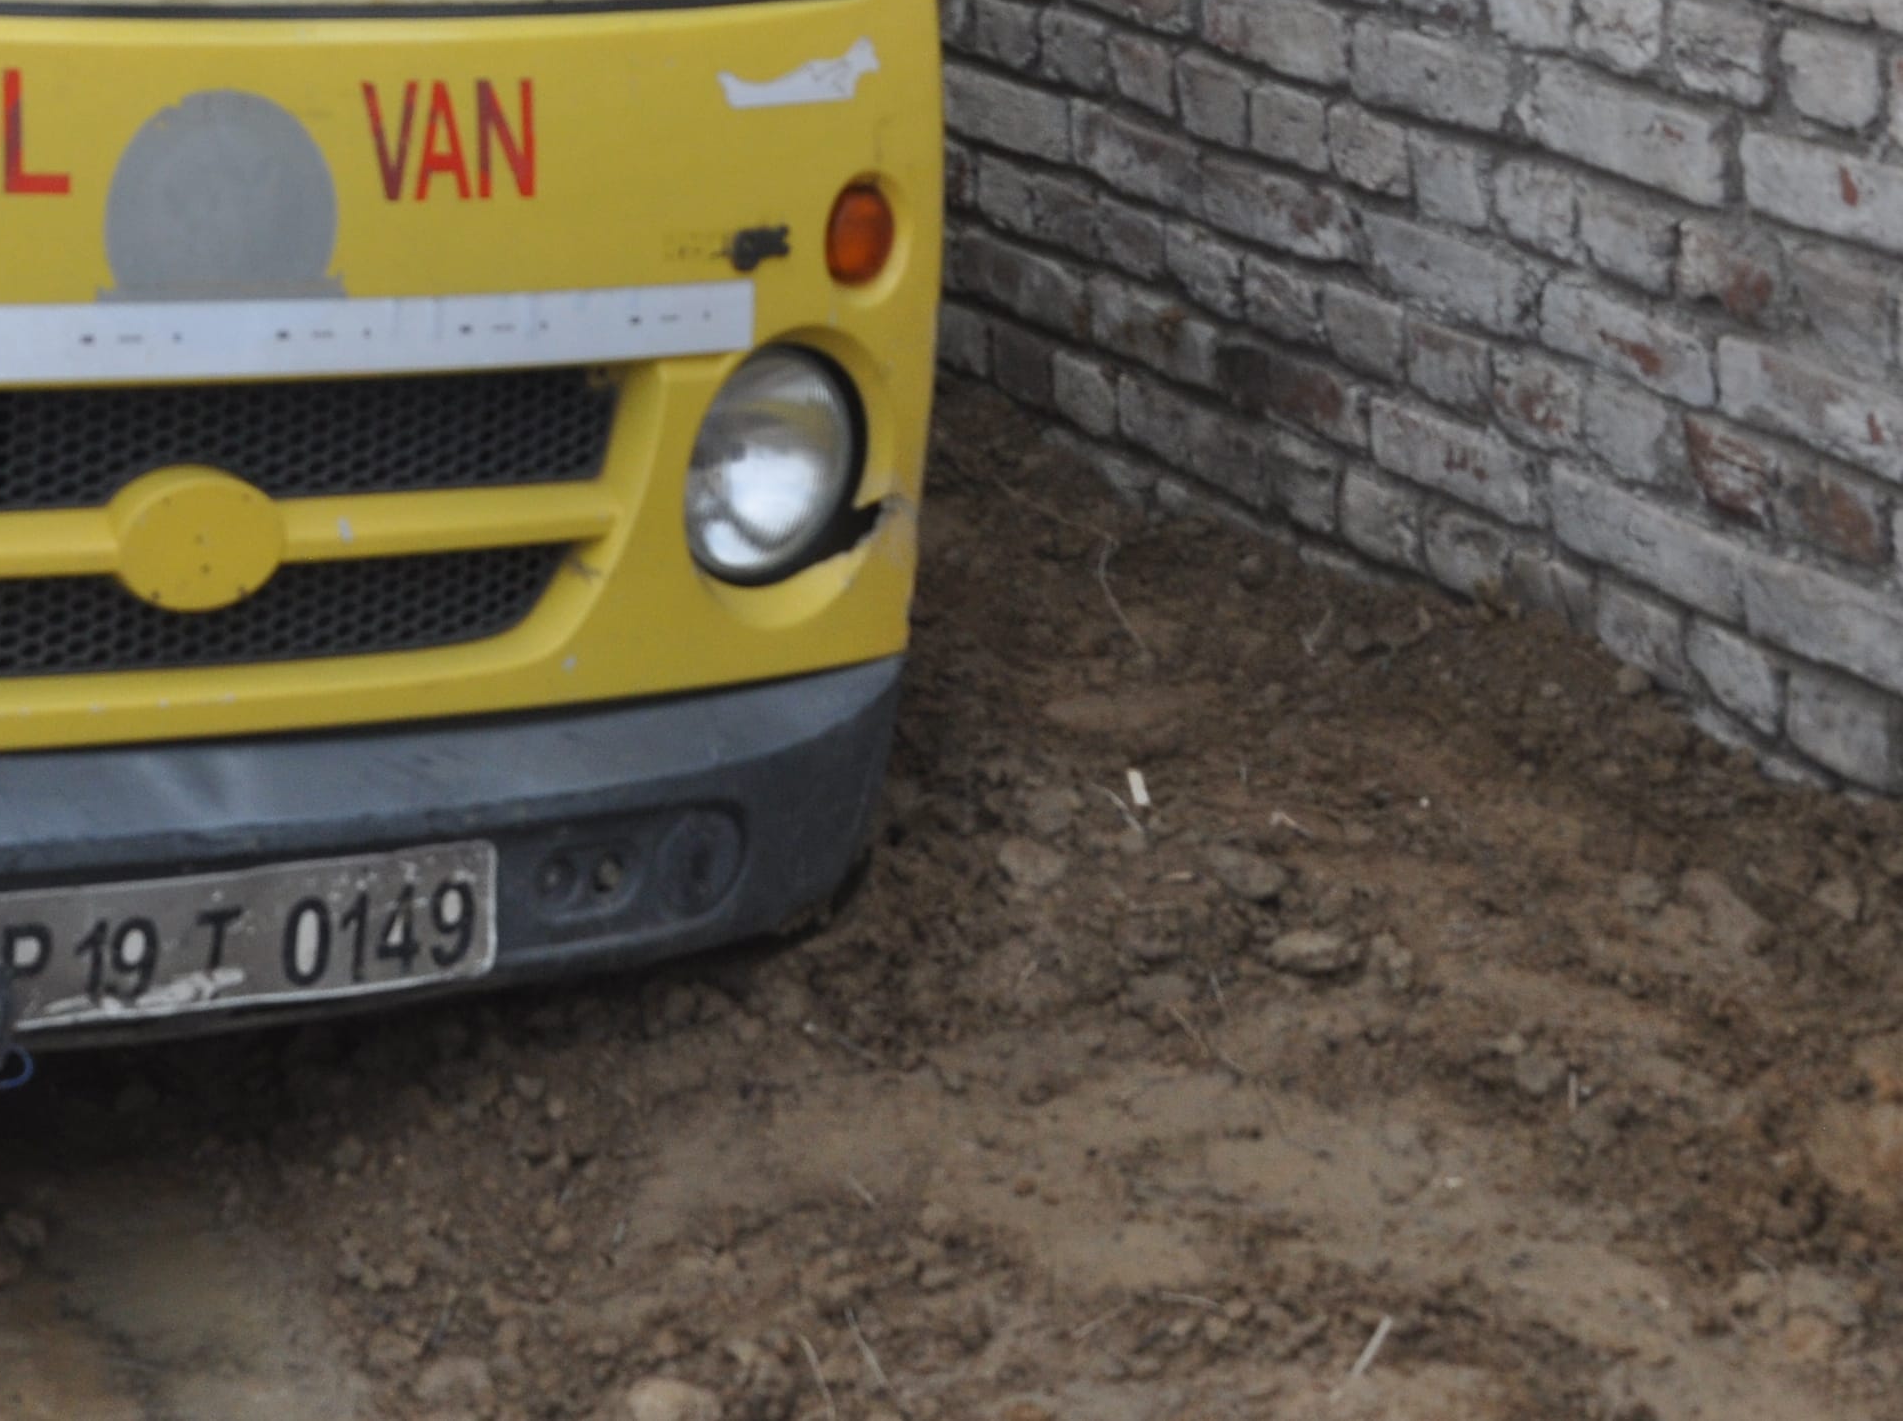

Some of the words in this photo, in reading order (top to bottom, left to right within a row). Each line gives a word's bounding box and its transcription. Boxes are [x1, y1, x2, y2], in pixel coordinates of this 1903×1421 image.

[362, 78, 536, 201] VAN
[73, 917, 158, 1005] 19
[284, 880, 475, 986] 0149
